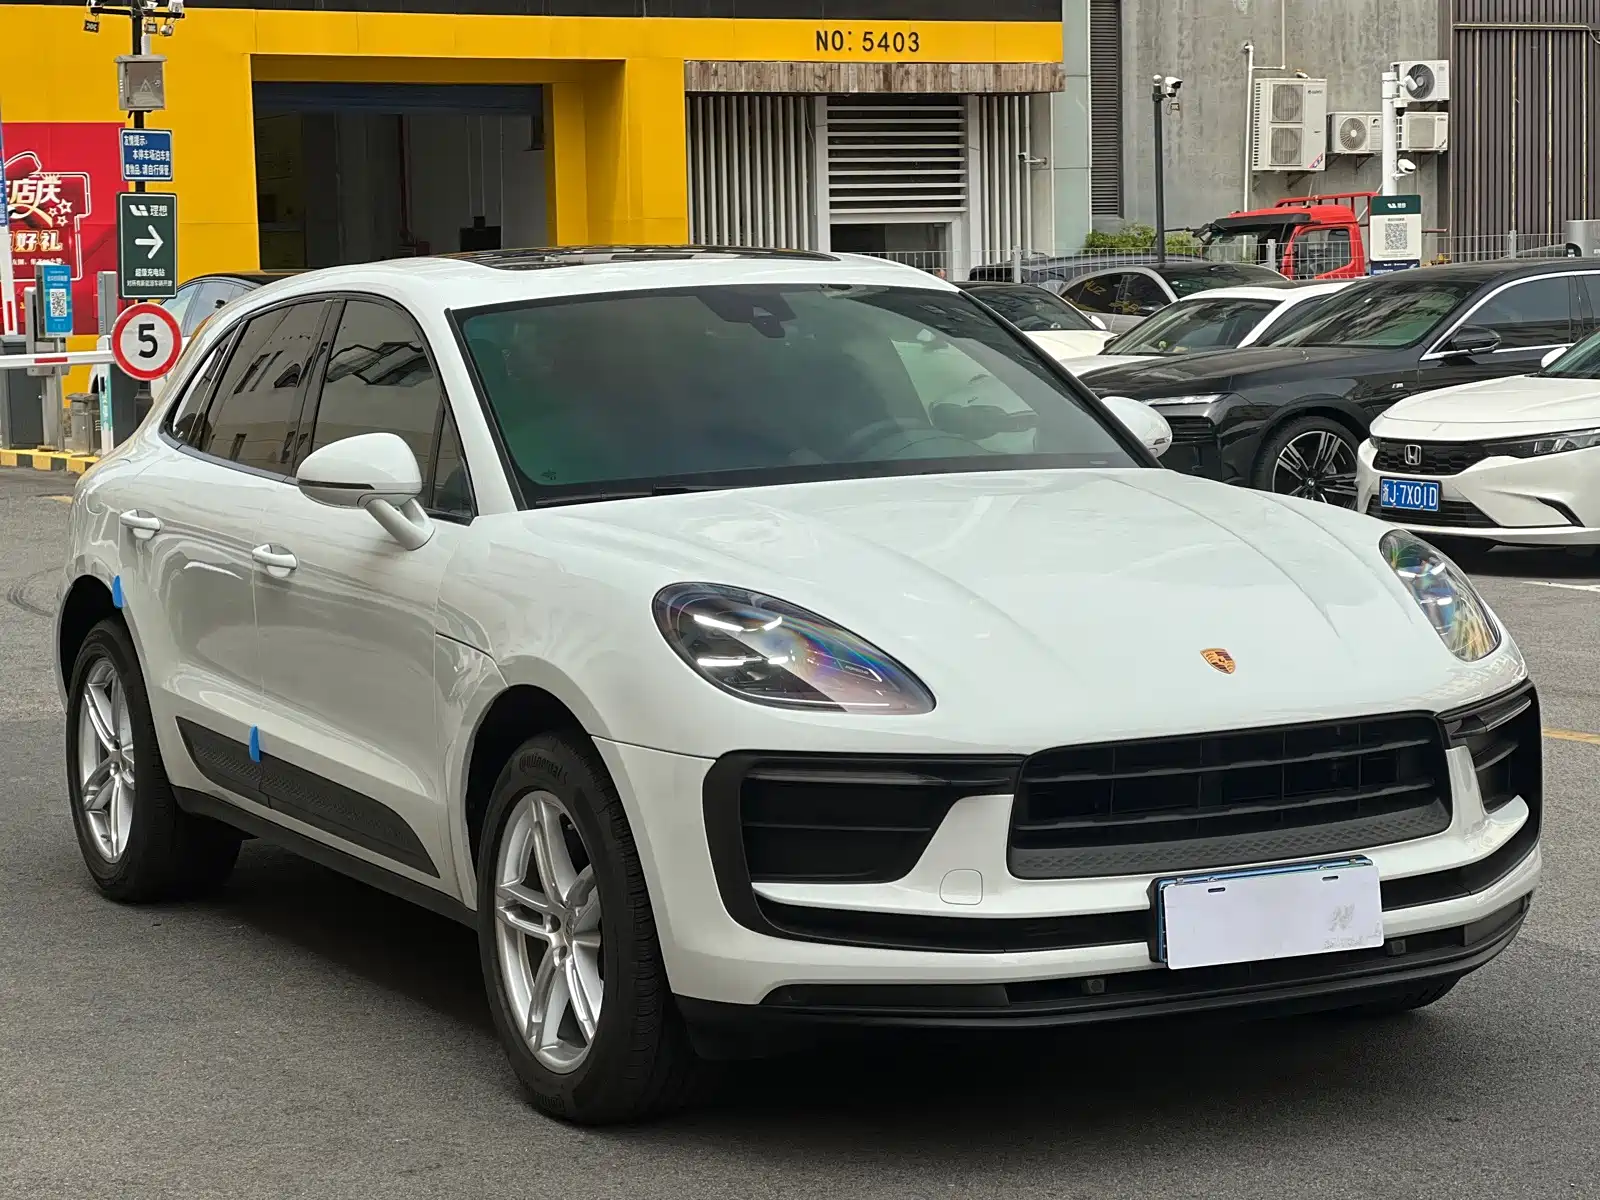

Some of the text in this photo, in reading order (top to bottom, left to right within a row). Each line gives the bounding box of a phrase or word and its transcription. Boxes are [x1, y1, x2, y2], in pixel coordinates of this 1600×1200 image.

[862, 31, 919, 53] 5403
[150, 205, 168, 216] 理想
[138, 323, 158, 359] 5
